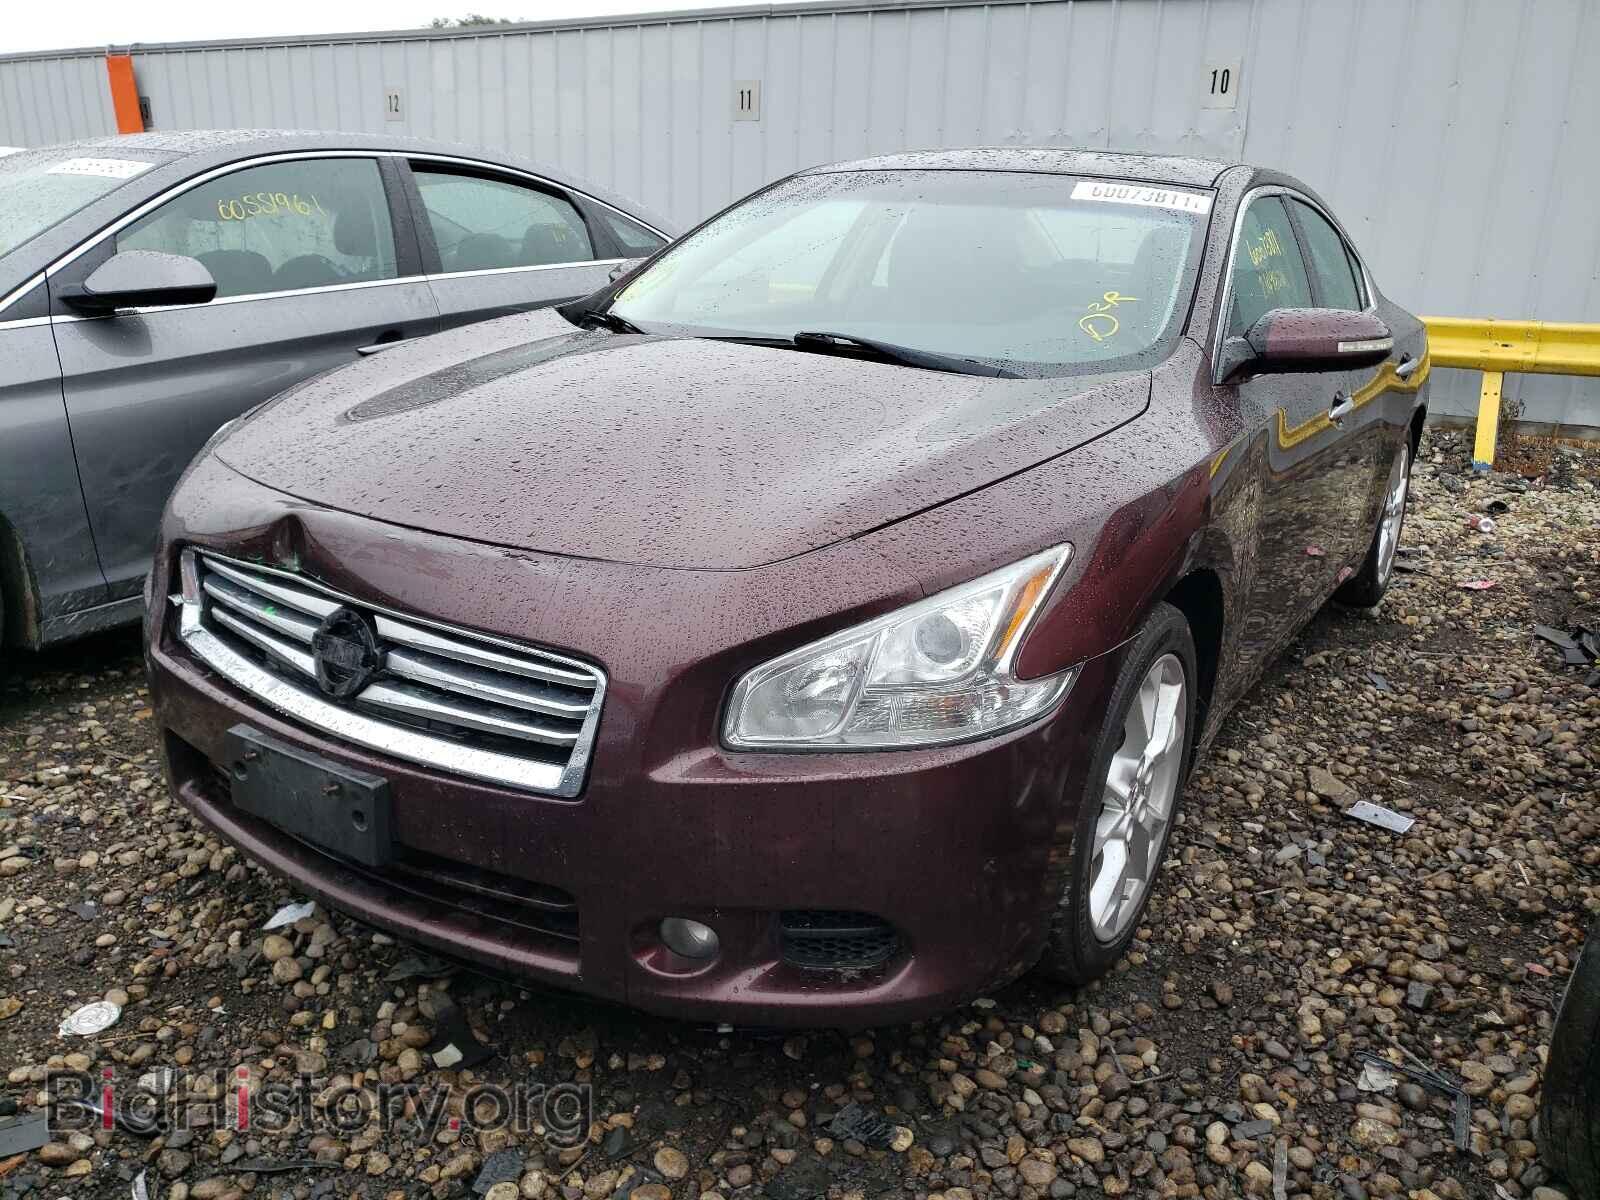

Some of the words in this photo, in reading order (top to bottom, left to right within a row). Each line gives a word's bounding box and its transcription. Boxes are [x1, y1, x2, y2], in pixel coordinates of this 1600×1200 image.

[1210, 68, 1230, 95] 10
[388, 94, 399, 113] 12
[740, 89, 751, 110] 11
